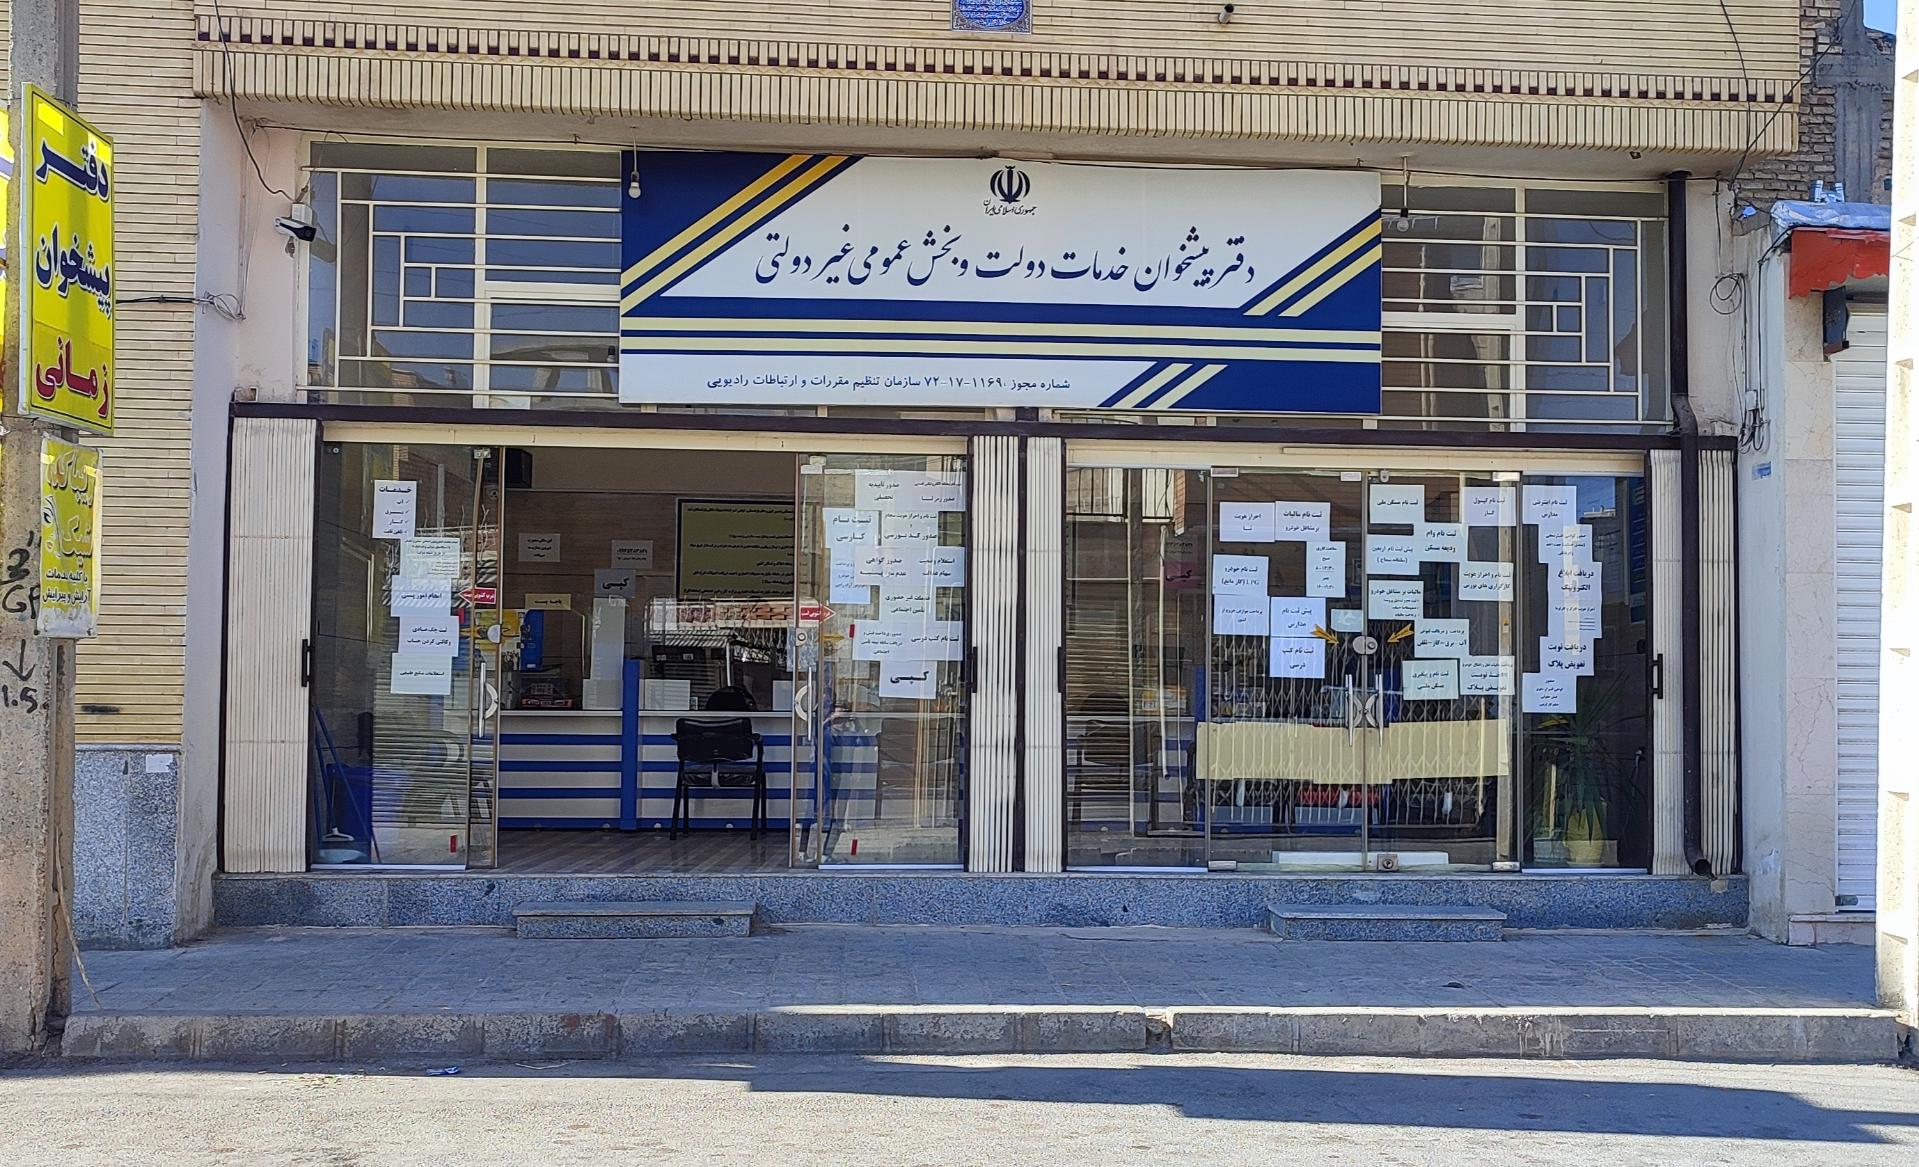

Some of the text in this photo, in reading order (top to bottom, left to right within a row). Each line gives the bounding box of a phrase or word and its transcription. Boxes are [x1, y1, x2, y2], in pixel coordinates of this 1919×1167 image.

[36, 138, 110, 202] دفتر
[755, 223, 1256, 292] دفتر پیشخوان خدمات دولت و بخش عمومی غیر دولتی
[35, 222, 112, 320] پیشخوان
[35, 336, 110, 419] زمانی
[706, 374, 749, 389] رادیویی
[752, 374, 798, 388] ارتباطات
[800, 378, 807, 389] و
[810, 374, 849, 389] مقررات
[852, 375, 880, 391] تنظیم
[884, 375, 920, 389] سازمان
[1010, 377, 1037, 391] مجوز
[1039, 377, 1071, 390] شماره
